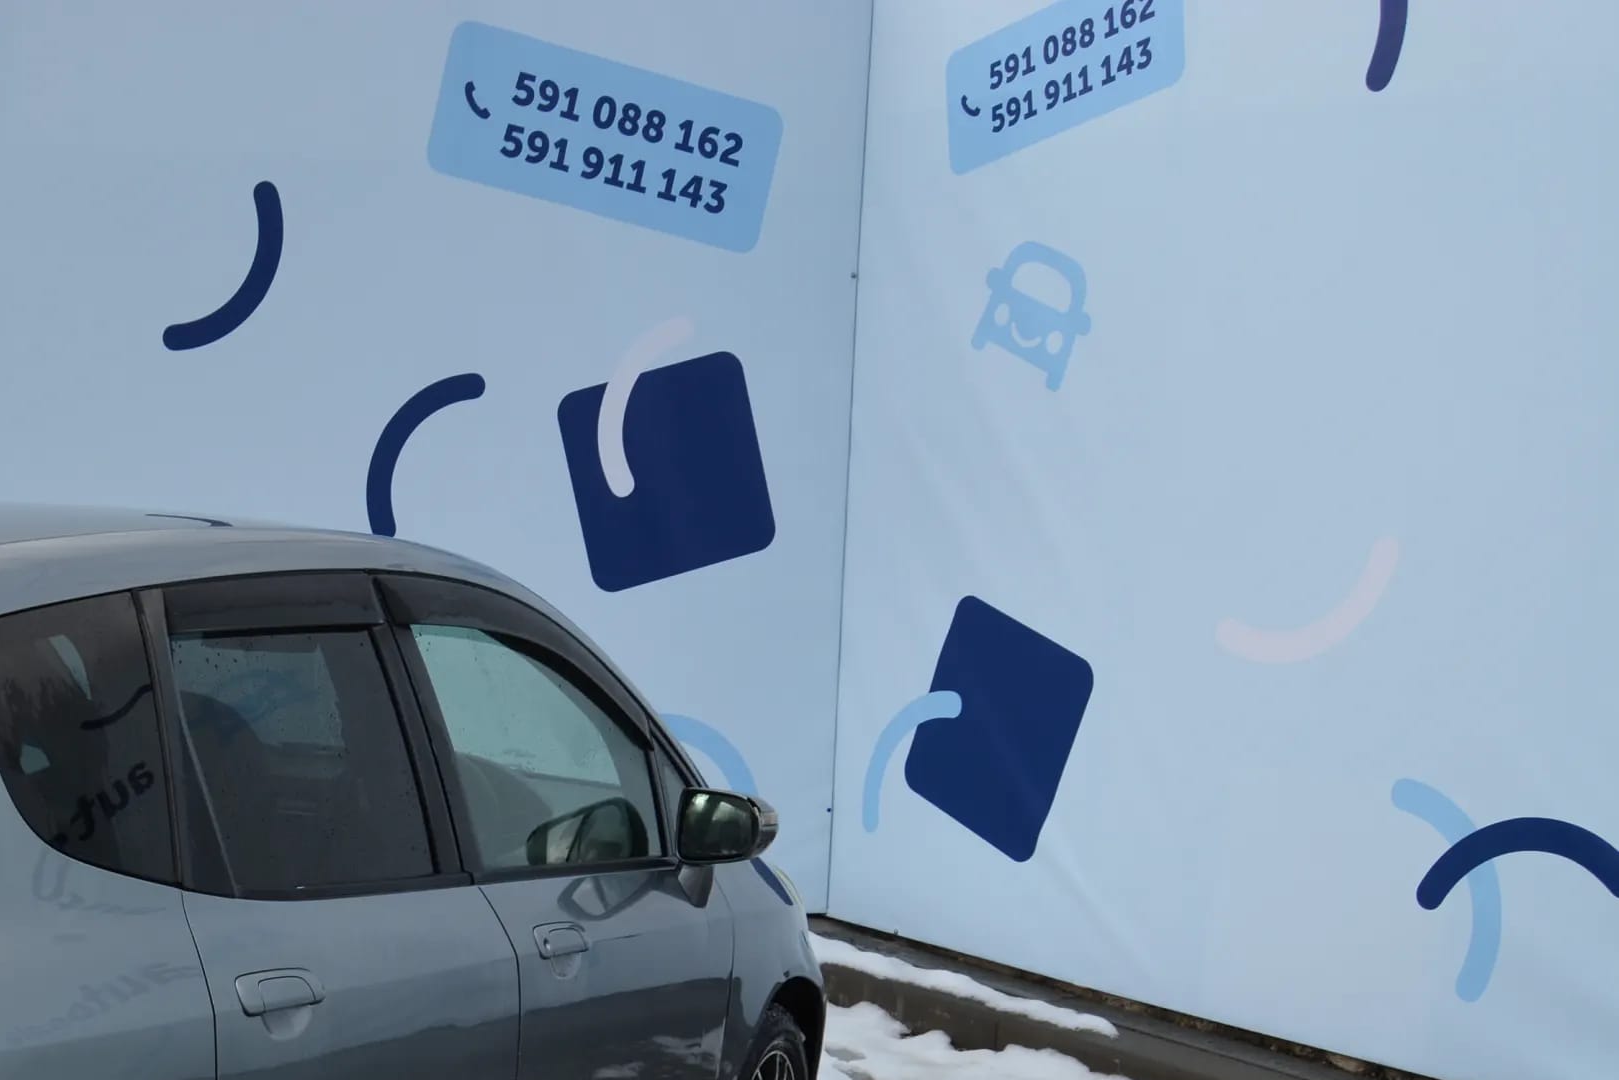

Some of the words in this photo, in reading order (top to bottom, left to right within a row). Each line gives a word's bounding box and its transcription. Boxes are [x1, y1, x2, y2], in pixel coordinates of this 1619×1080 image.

[989, 45, 1036, 90] 591
[1042, 17, 1095, 65] 088
[1103, 0, 1156, 39] 162
[991, 89, 1038, 133] 591
[1043, 64, 1093, 111] 911
[1100, 36, 1153, 87] 143
[511, 71, 580, 122] 591
[592, 95, 666, 143] 088
[673, 119, 743, 167] 162
[499, 123, 570, 173] 591
[580, 146, 647, 194] 911
[656, 168, 728, 214] 143
